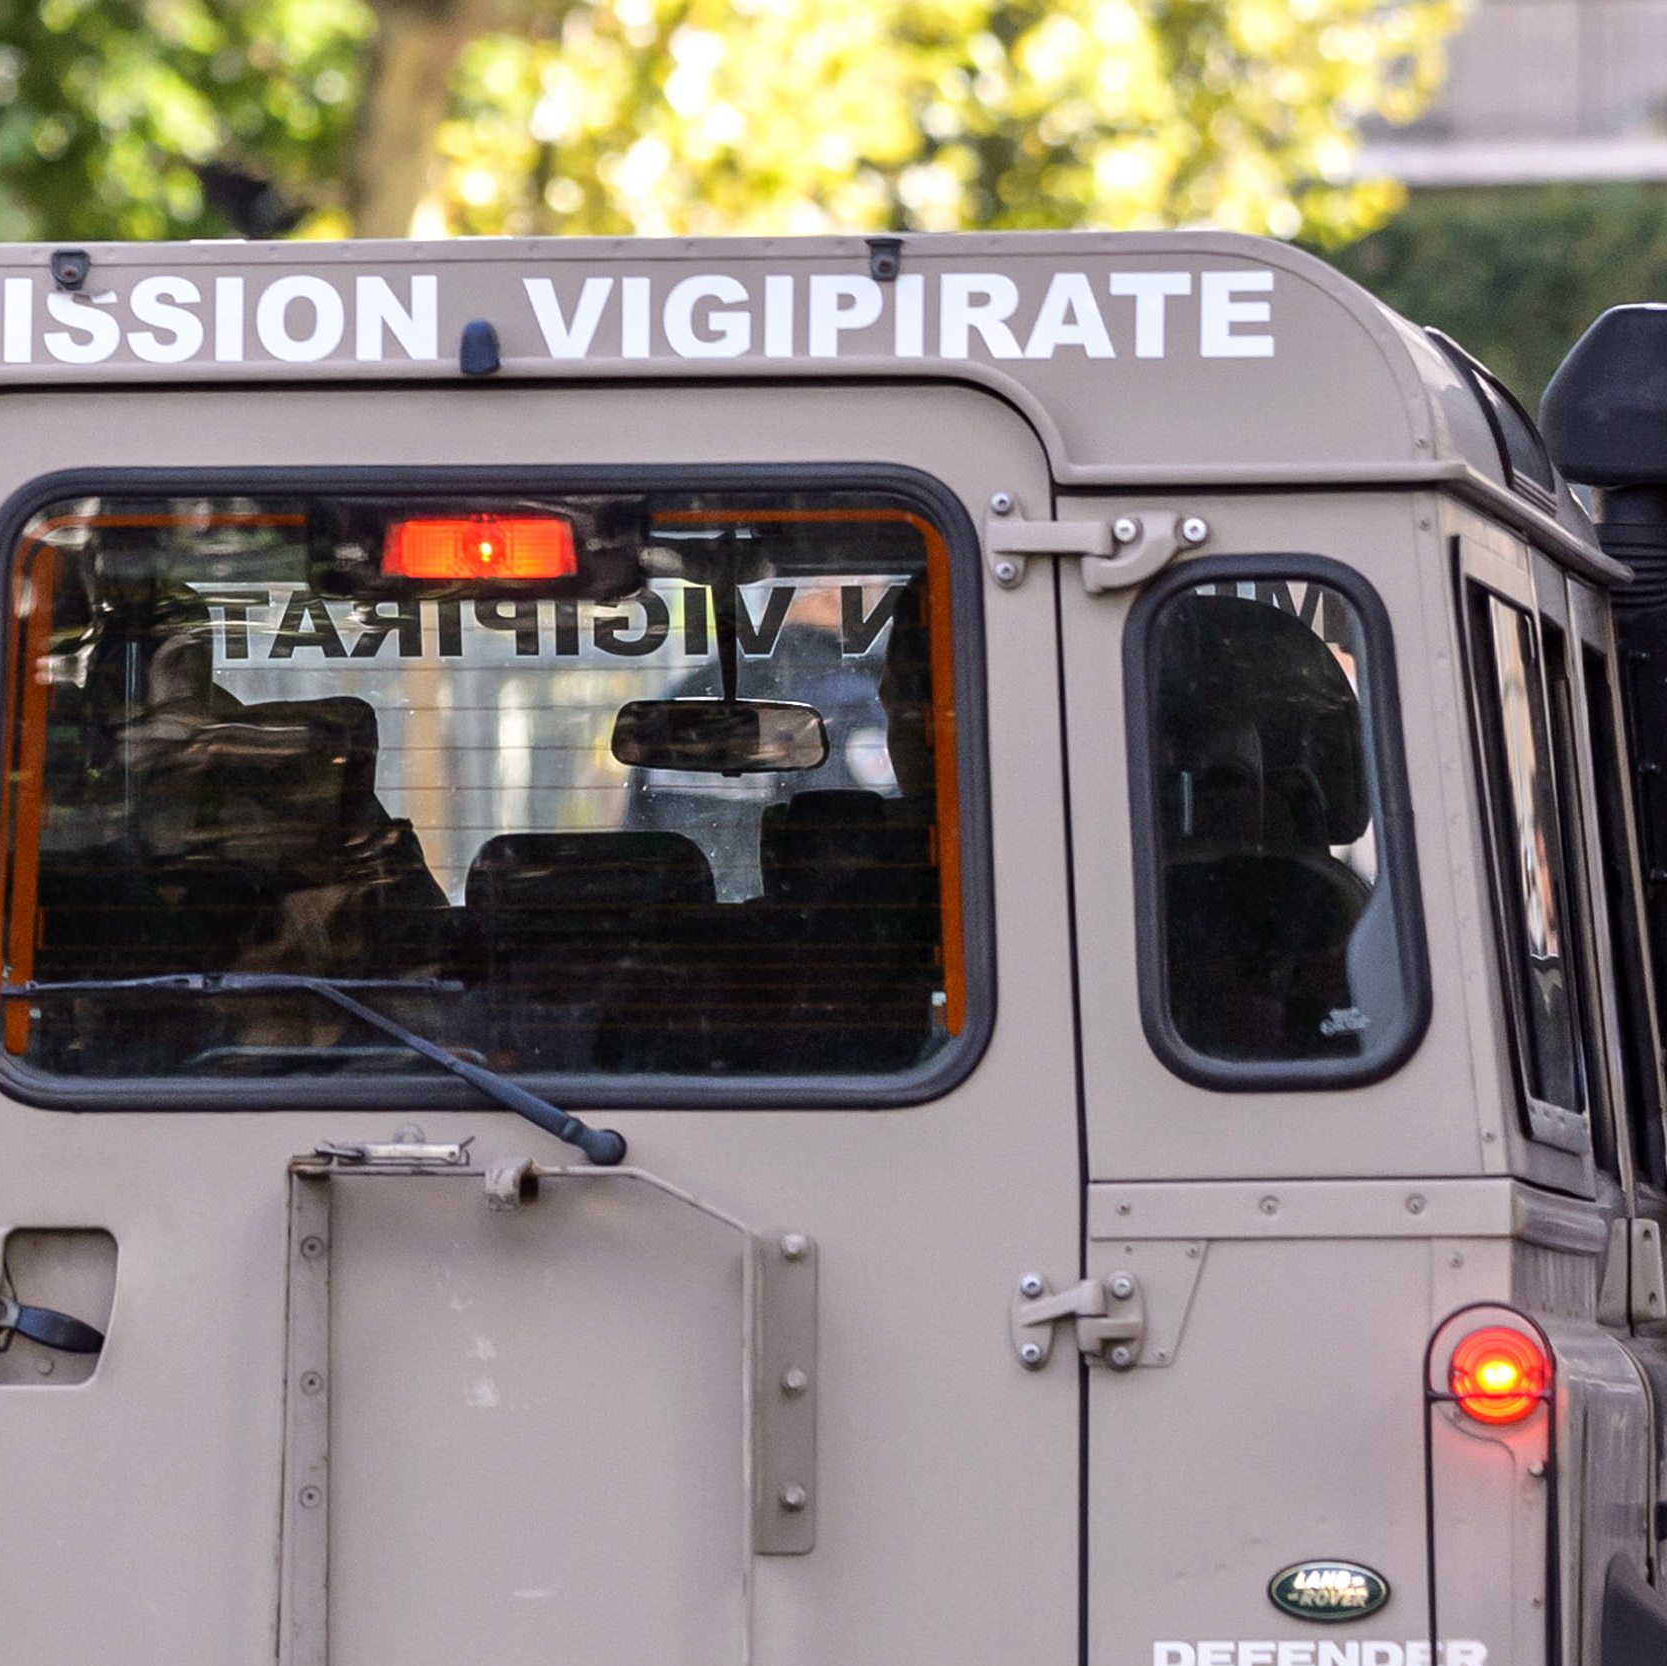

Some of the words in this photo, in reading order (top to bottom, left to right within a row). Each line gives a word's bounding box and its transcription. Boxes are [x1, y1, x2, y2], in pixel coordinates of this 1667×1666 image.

[523, 271, 1275, 360] VIGIPIRATE
[1293, 1570, 1352, 1590] LAND
[1298, 1588, 1369, 1607] ROVER
